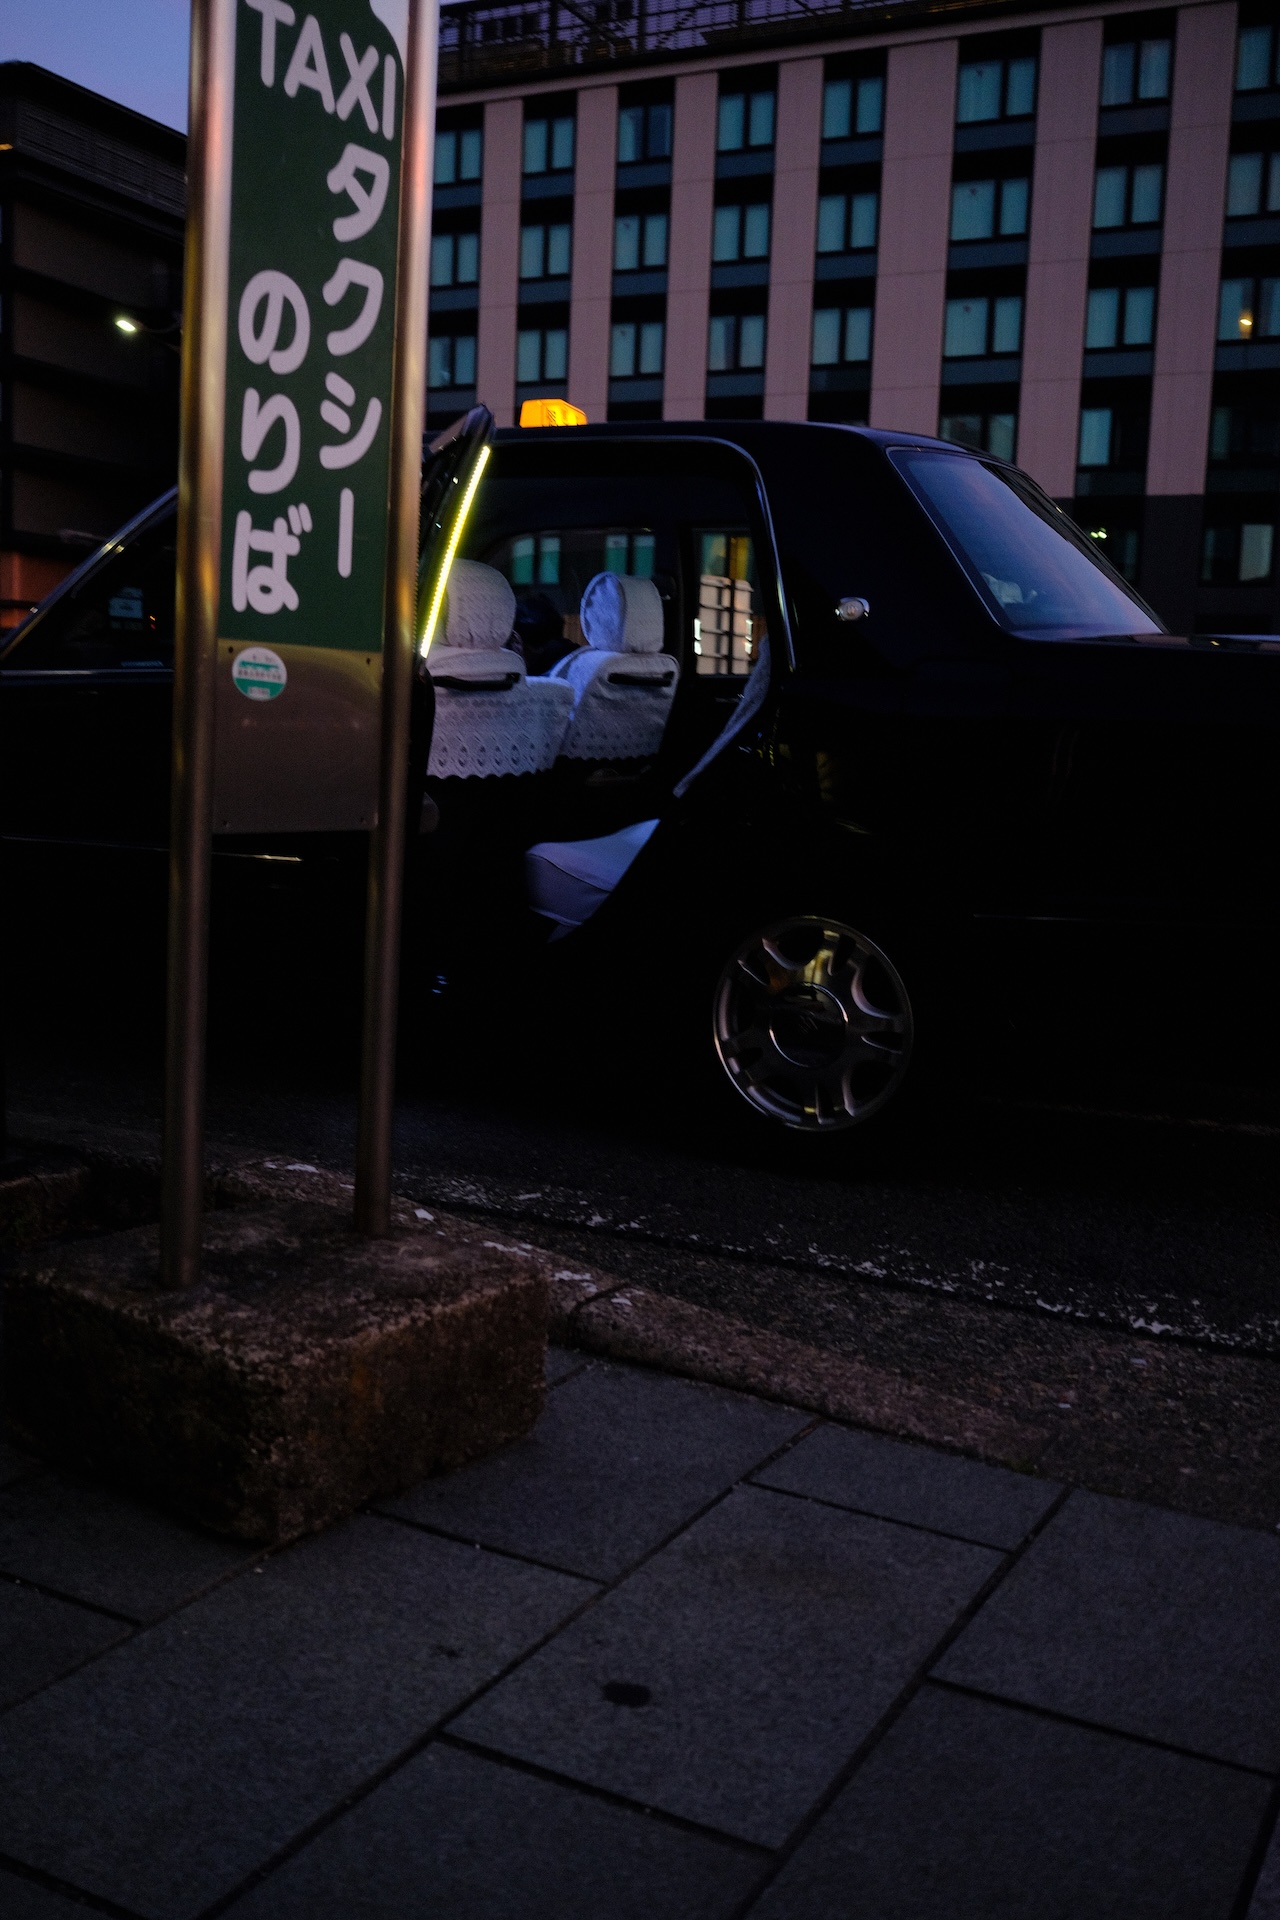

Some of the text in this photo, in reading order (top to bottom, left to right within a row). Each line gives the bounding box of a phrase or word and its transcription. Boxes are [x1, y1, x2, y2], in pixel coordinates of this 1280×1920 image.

[245, 0, 396, 141] TAXI
[231, 269, 313, 615] のりば
[319, 142, 391, 579] タクシー
